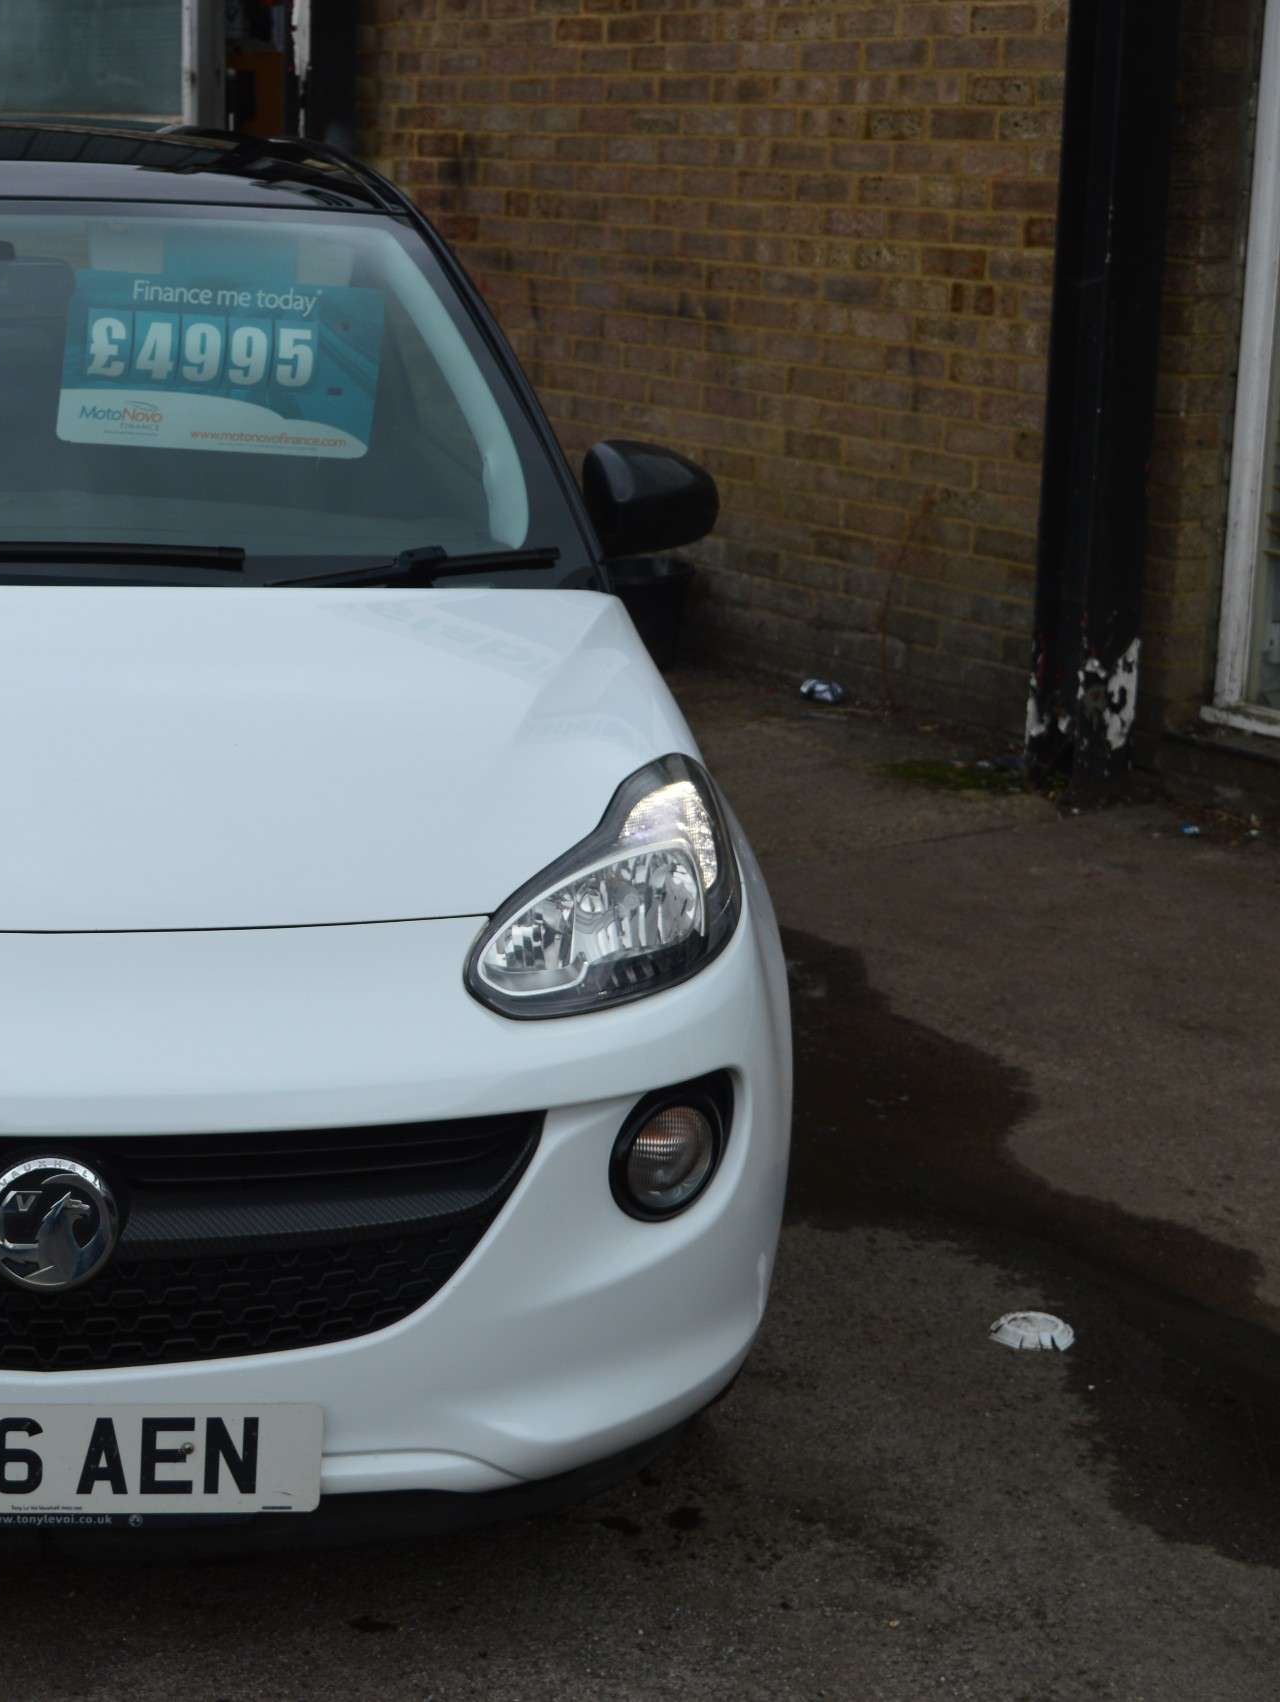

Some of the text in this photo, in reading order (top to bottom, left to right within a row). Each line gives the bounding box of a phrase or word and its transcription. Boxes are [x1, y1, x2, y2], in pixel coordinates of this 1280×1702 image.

[132, 280, 212, 305] Finance
[217, 289, 251, 308] me
[86, 317, 314, 387] £4995
[79, 404, 163, 423] MotoNovo
[76, 1416, 260, 1496] AEN
